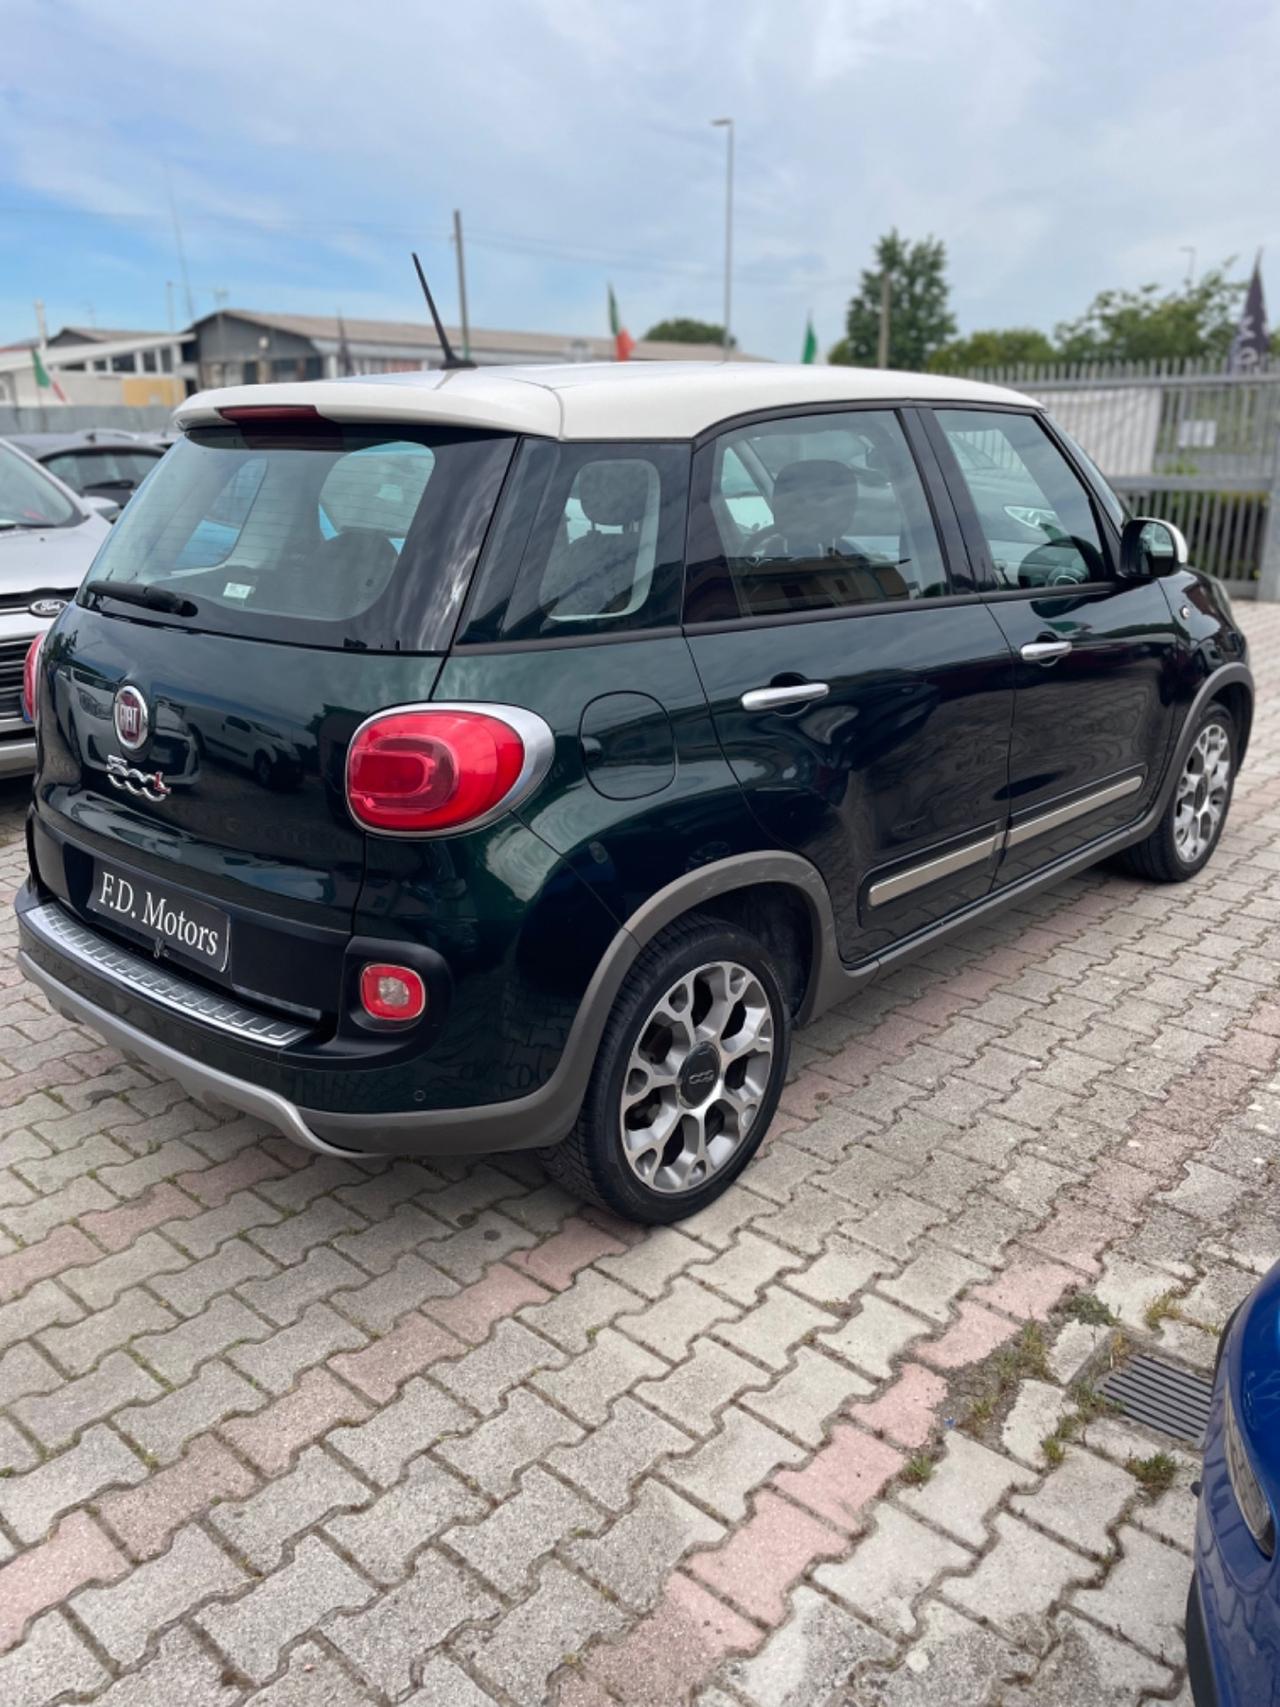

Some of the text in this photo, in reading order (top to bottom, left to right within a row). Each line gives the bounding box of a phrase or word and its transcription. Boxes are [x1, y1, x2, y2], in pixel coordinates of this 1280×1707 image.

[120, 703, 138, 733] FIAT
[98, 871, 218, 956] F.D. Motors
